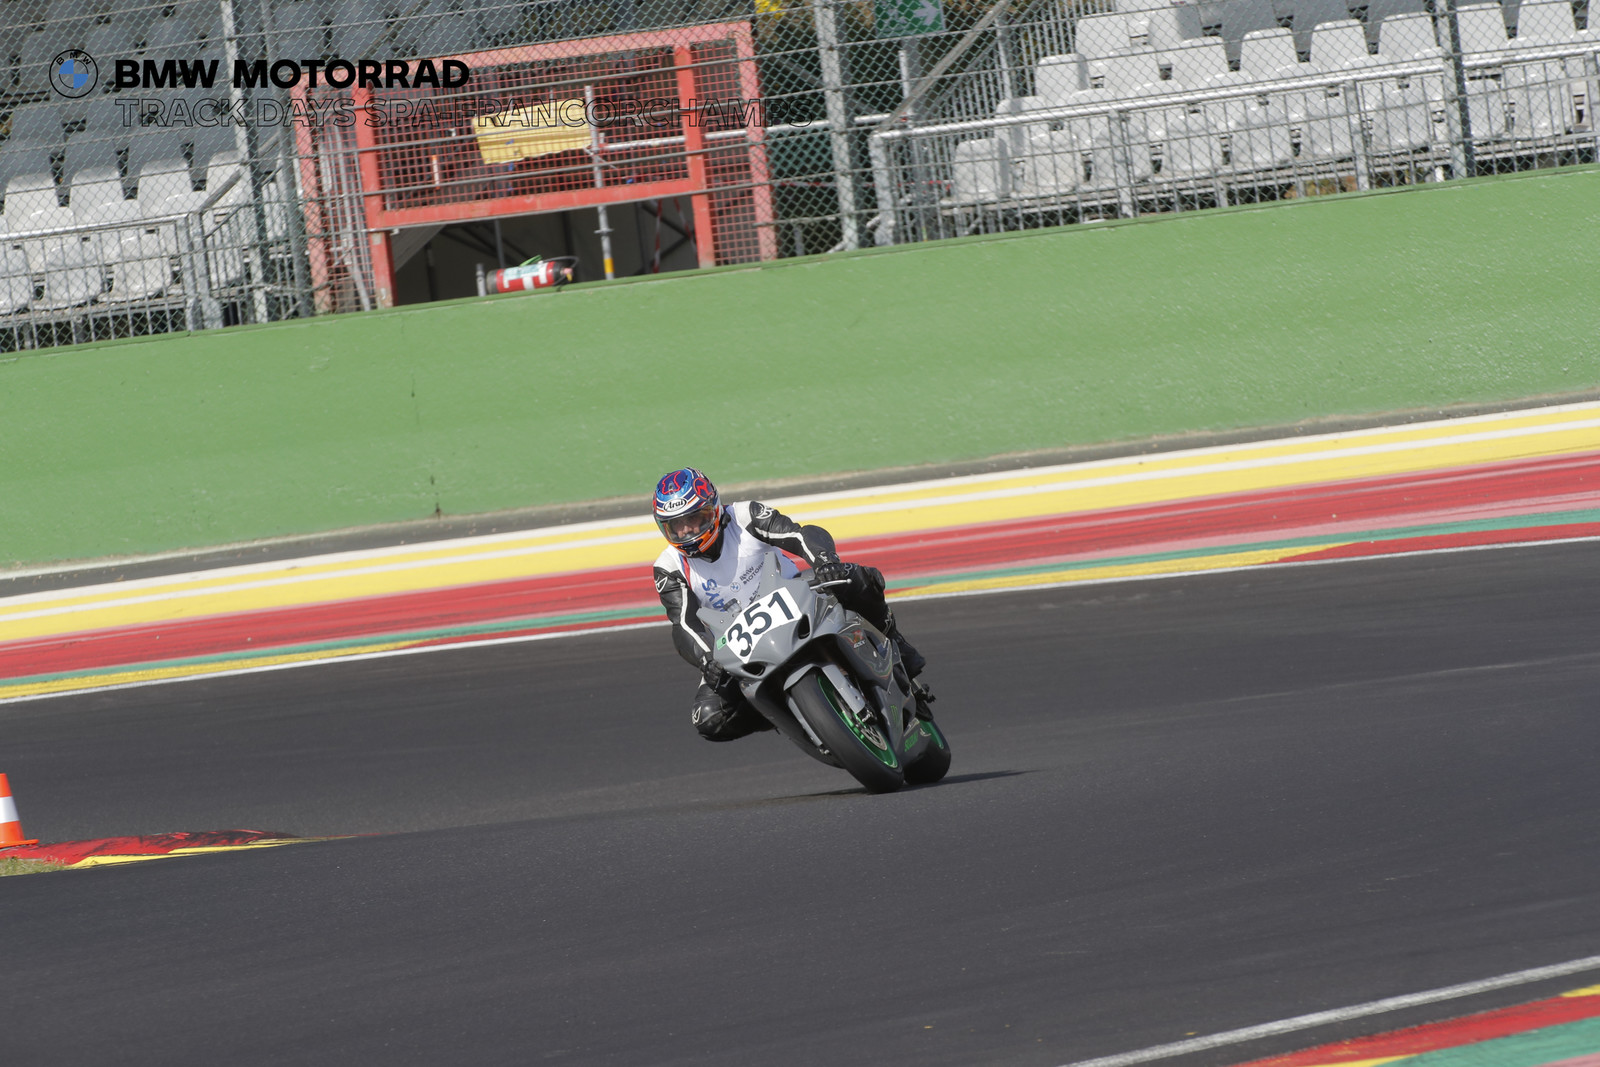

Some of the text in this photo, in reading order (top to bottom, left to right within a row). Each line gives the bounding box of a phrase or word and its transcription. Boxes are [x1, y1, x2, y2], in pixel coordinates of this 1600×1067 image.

[739, 566, 755, 581] BMW
[702, 578, 726, 612] AYS
[727, 591, 794, 657] 351
